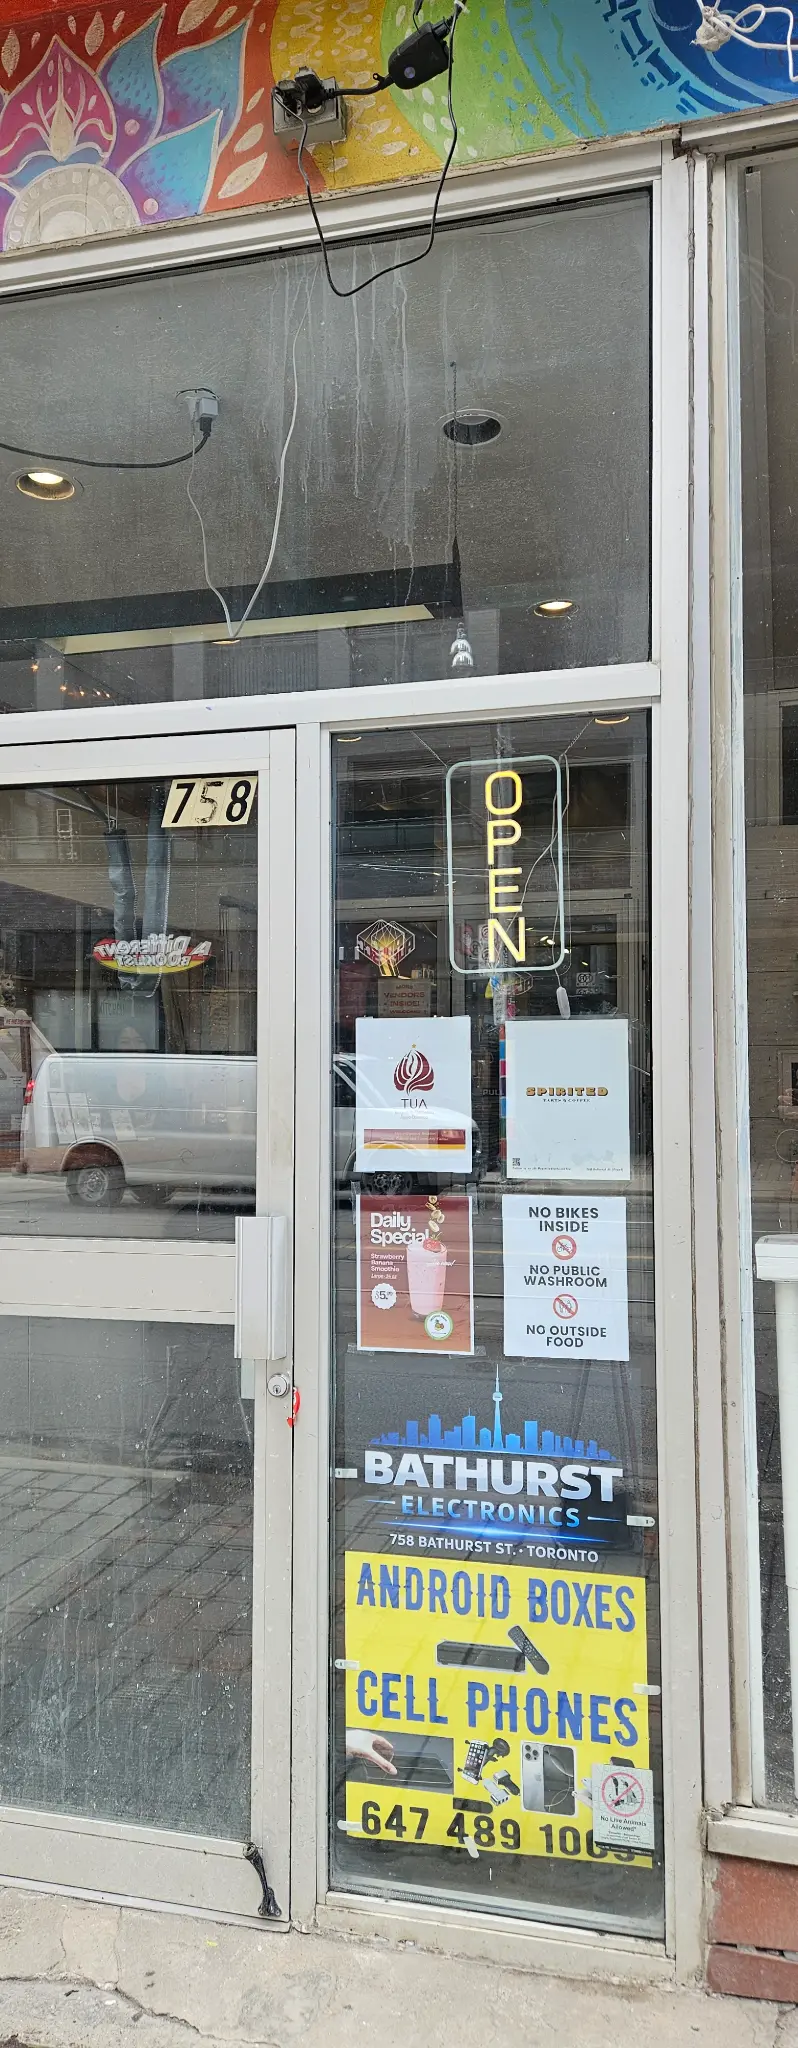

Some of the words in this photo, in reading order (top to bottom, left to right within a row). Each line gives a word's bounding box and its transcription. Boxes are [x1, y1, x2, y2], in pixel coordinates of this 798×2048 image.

[170, 780, 252, 823] 758
[485, 770, 526, 962] OPEN
[384, 991, 426, 999] VENDORS
[526, 1087, 609, 1097] SPIRITED
[400, 1098, 428, 1109] TUA
[528, 1206, 551, 1218] NO
[555, 1207, 599, 1219] BIKES
[370, 1211, 412, 1232] Daily
[539, 1220, 589, 1233] INSIDE
[370, 1228, 430, 1248] Special
[370, 1252, 405, 1261] Strawberry
[370, 1265, 400, 1273] Smoothie
[529, 1264, 550, 1275] NO
[553, 1265, 601, 1276] PUBLIC
[524, 1276, 608, 1288] WASHROOM
[526, 1324, 546, 1335] NO
[549, 1325, 607, 1338] OUTSIDE
[546, 1337, 584, 1348] FOOD
[364, 1450, 624, 1502] BATHURST
[401, 1495, 580, 1528] ELECTRONICS
[389, 1533, 415, 1547] 758
[418, 1535, 492, 1553] BATHURST
[495, 1542, 517, 1556] ST.
[526, 1546, 599, 1563] TORONTO
[356, 1562, 511, 1620] ANDROID
[527, 1578, 636, 1633] BOXES
[356, 1669, 448, 1725] CELL
[465, 1681, 639, 1748] PHONES
[610, 1816, 622, 1824] Live
[623, 1818, 647, 1827] Animals
[361, 1800, 429, 1840] 647
[446, 1812, 521, 1850] 489
[538, 1823, 636, 1863] 100
